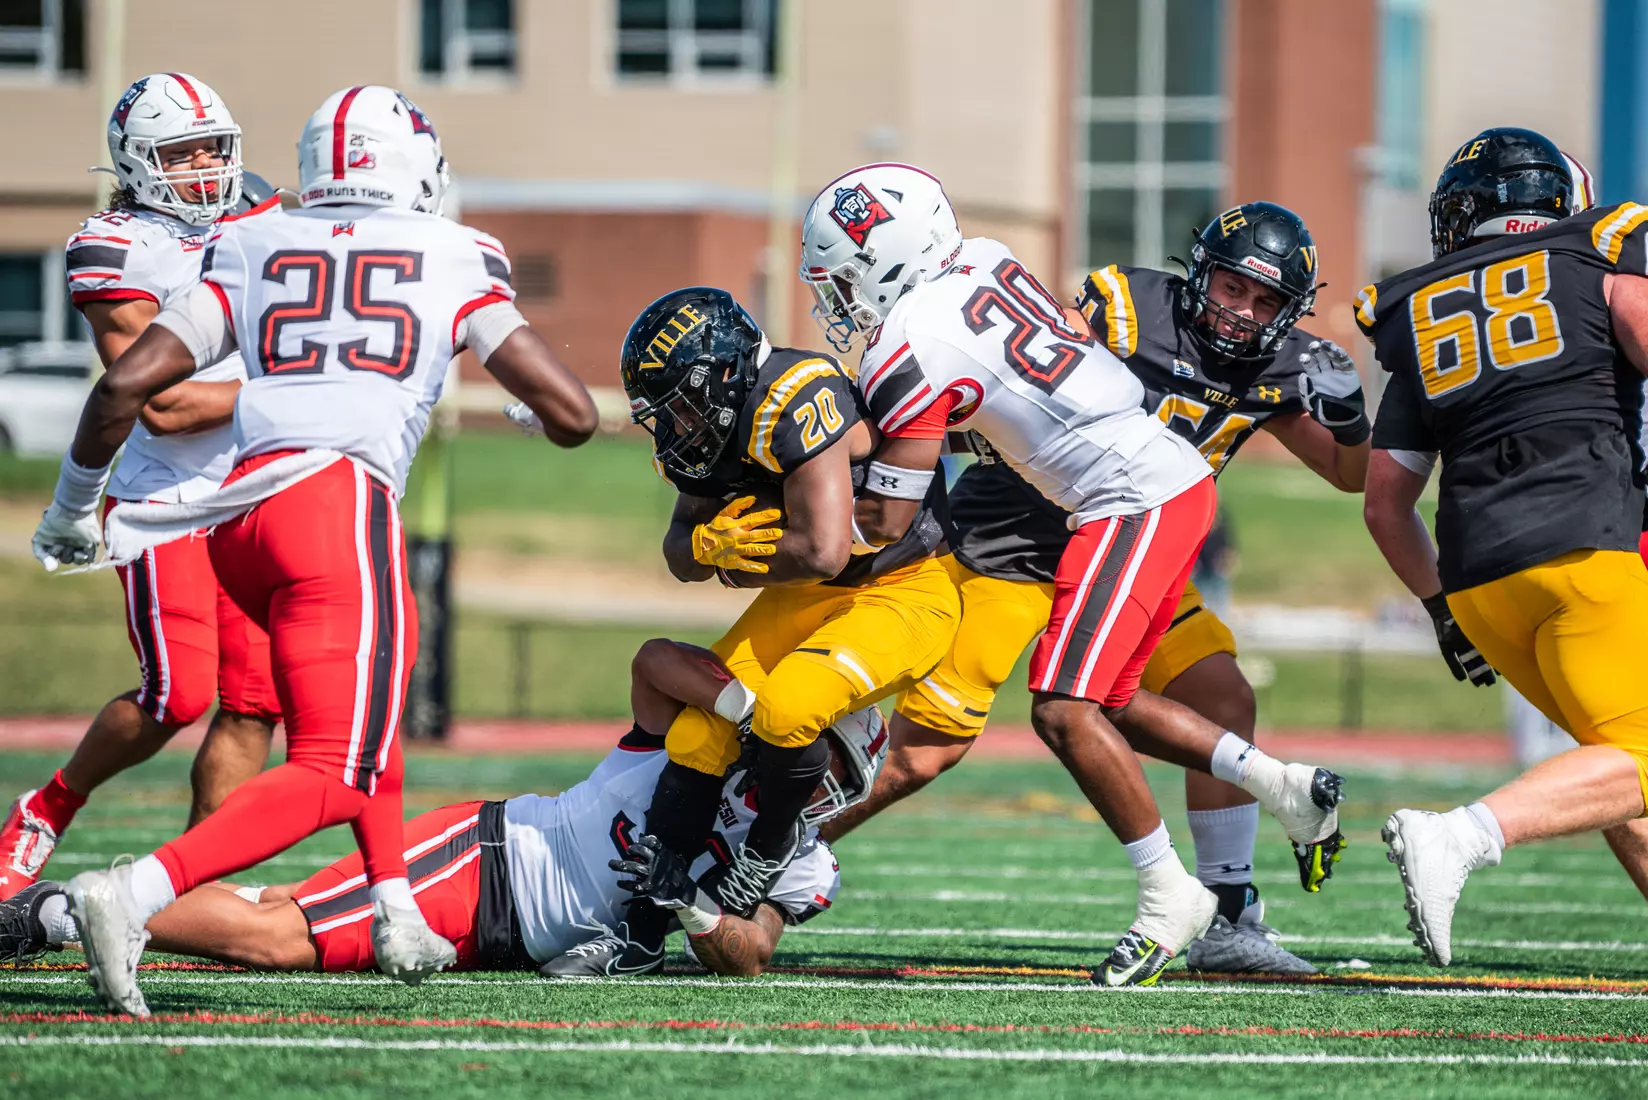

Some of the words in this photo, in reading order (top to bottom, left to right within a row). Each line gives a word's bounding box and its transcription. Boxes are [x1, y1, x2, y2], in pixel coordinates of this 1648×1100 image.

[349, 133, 365, 147] 25
[326, 186, 356, 198] RUNS
[360, 188, 394, 202] THICK
[1247, 258, 1279, 278] Riddell
[258, 249, 424, 383] 25
[640, 304, 707, 371] VILLE
[961, 258, 1095, 396] 20
[1410, 249, 1565, 399] 68
[793, 387, 845, 455] 20
[1203, 387, 1239, 409] VILLE
